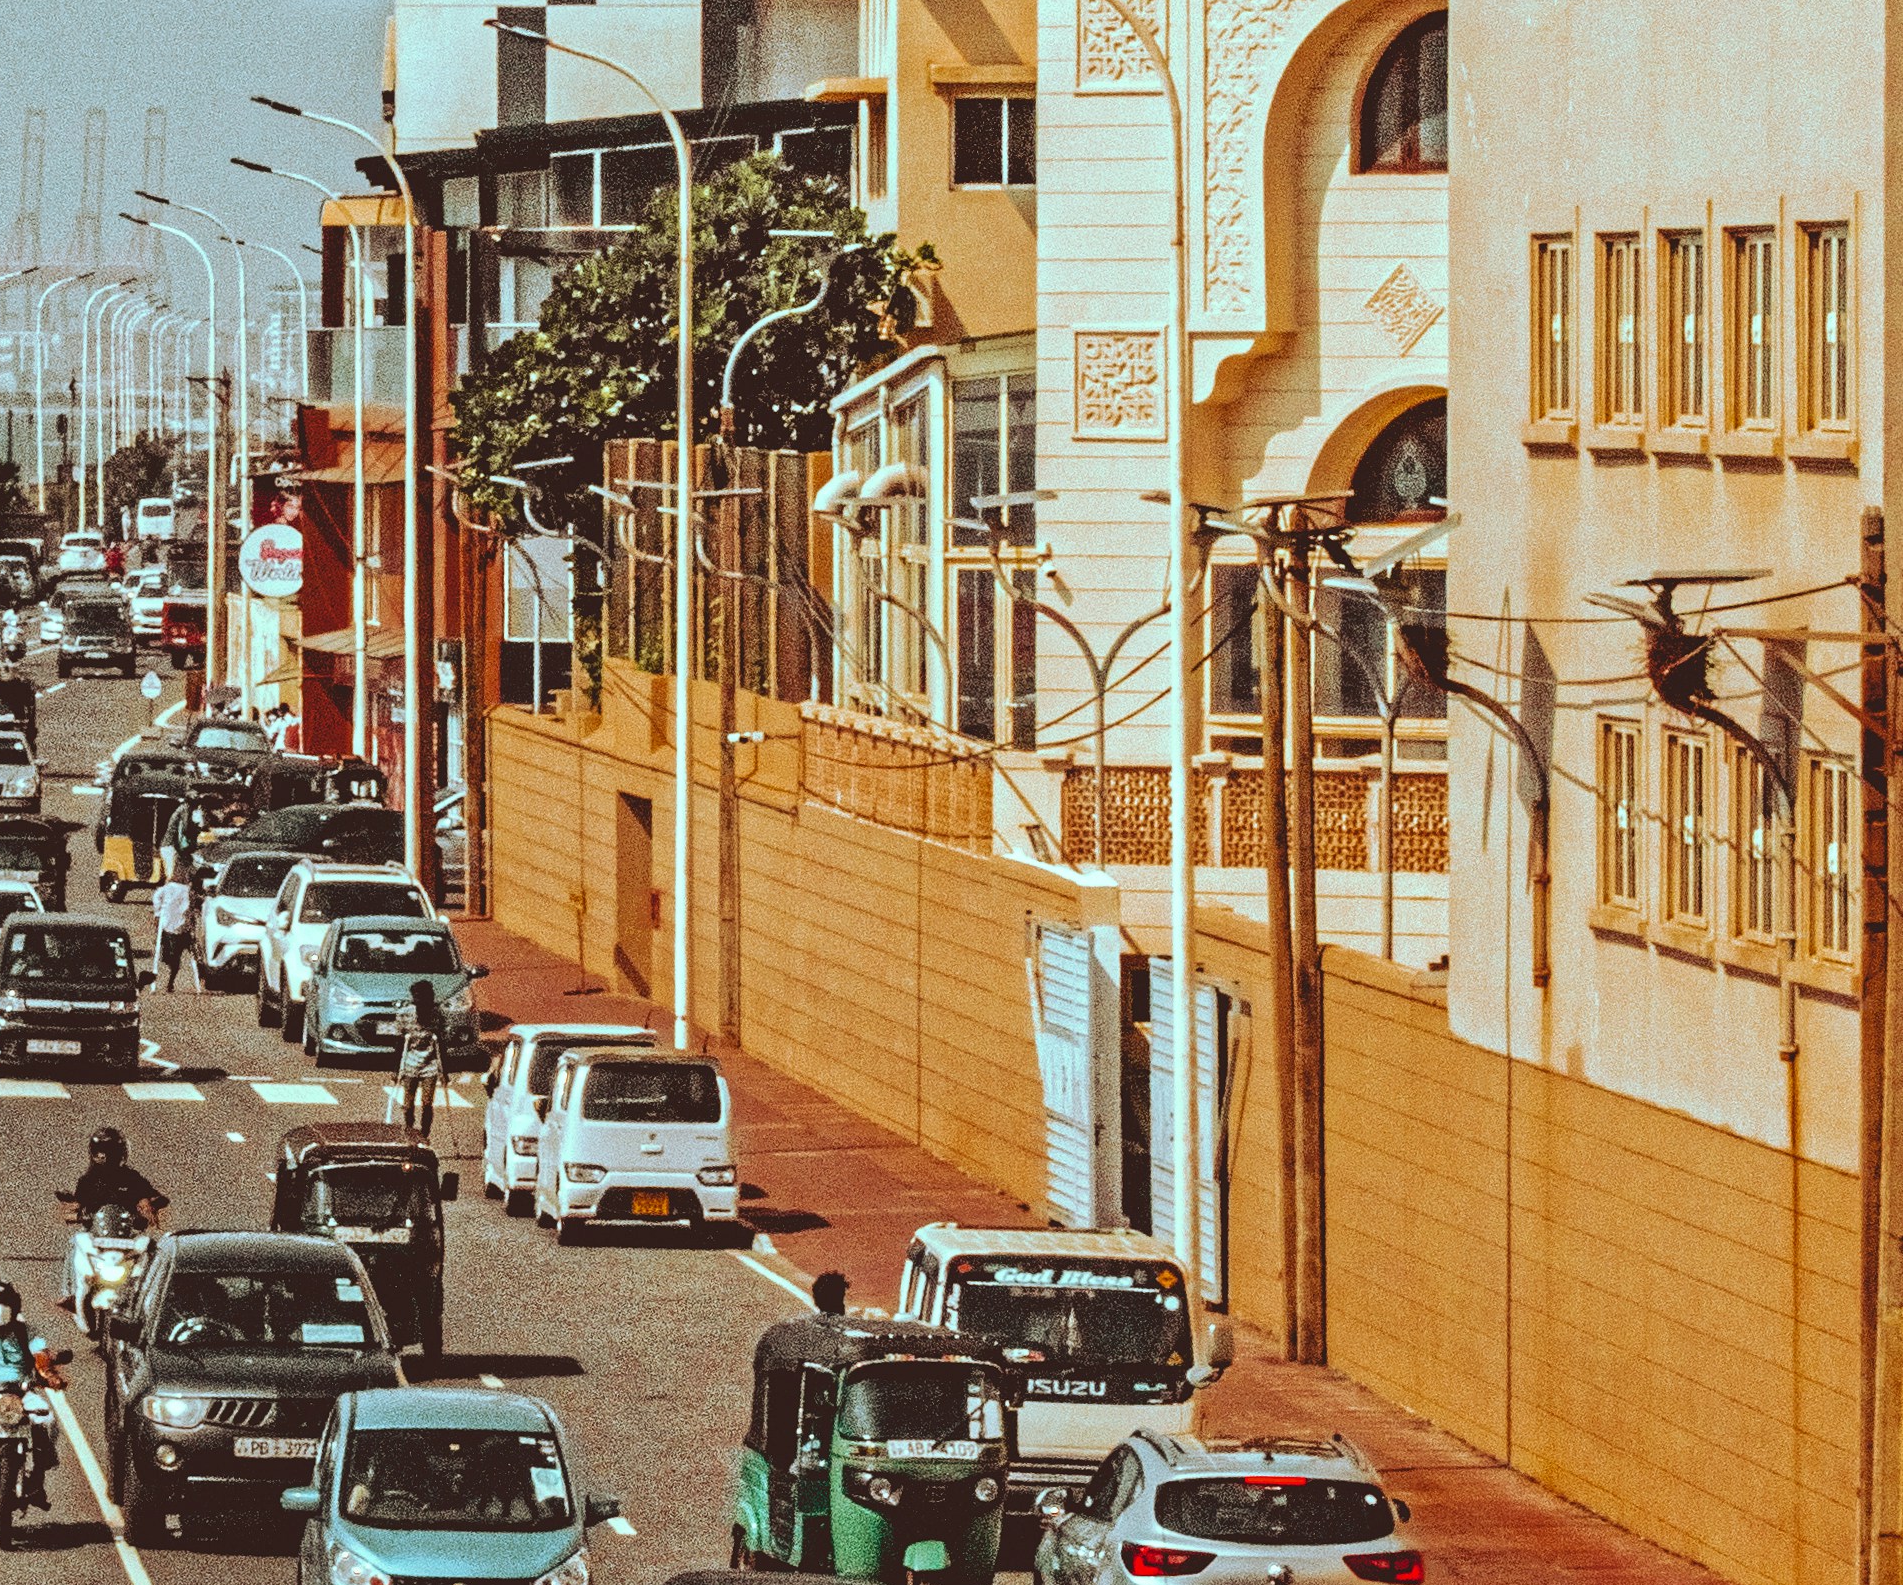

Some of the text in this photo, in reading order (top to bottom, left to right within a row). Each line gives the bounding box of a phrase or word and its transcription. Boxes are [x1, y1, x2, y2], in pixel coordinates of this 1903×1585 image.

[994, 1267, 1134, 1287] God Bless
[1027, 1378, 1106, 1397] ISUZU
